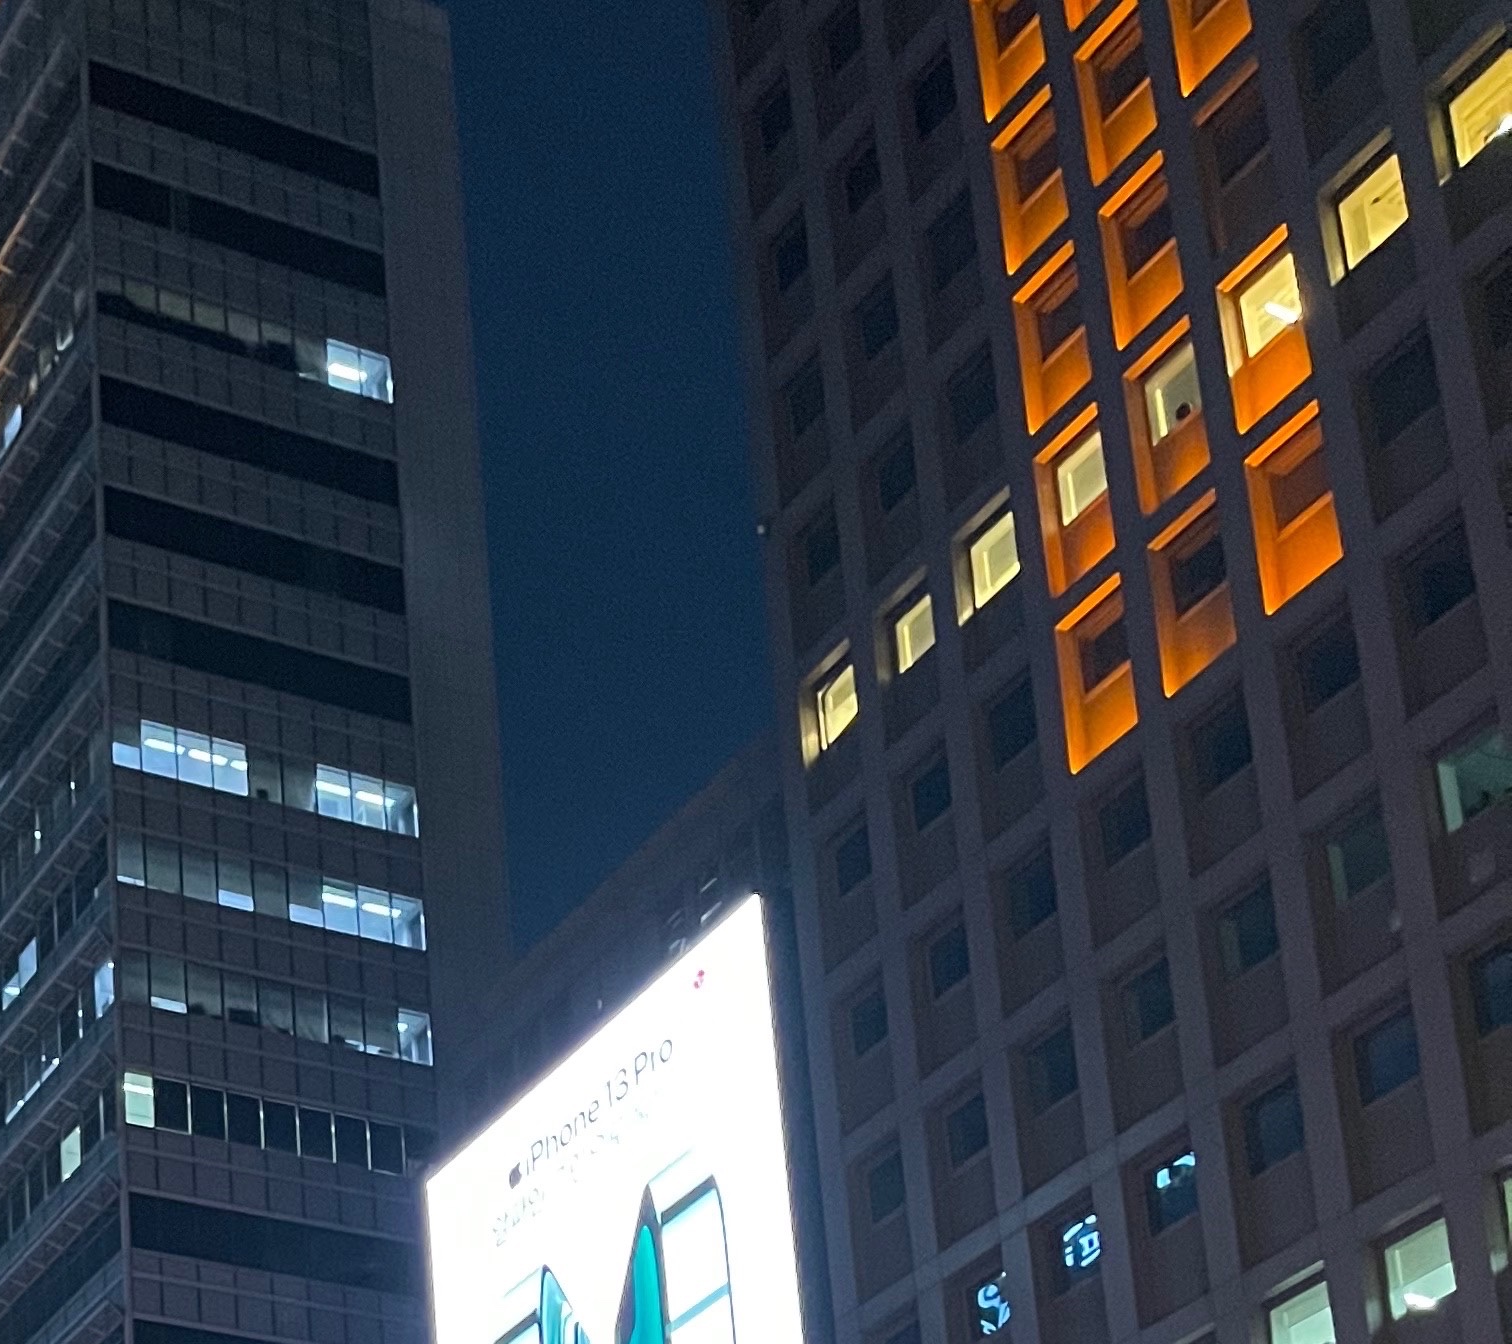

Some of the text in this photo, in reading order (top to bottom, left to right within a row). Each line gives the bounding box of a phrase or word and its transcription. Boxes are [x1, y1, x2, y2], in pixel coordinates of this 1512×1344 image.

[524, 1098, 600, 1176] iPhone
[605, 1067, 630, 1109] 13
[633, 1038, 674, 1086] Pro
